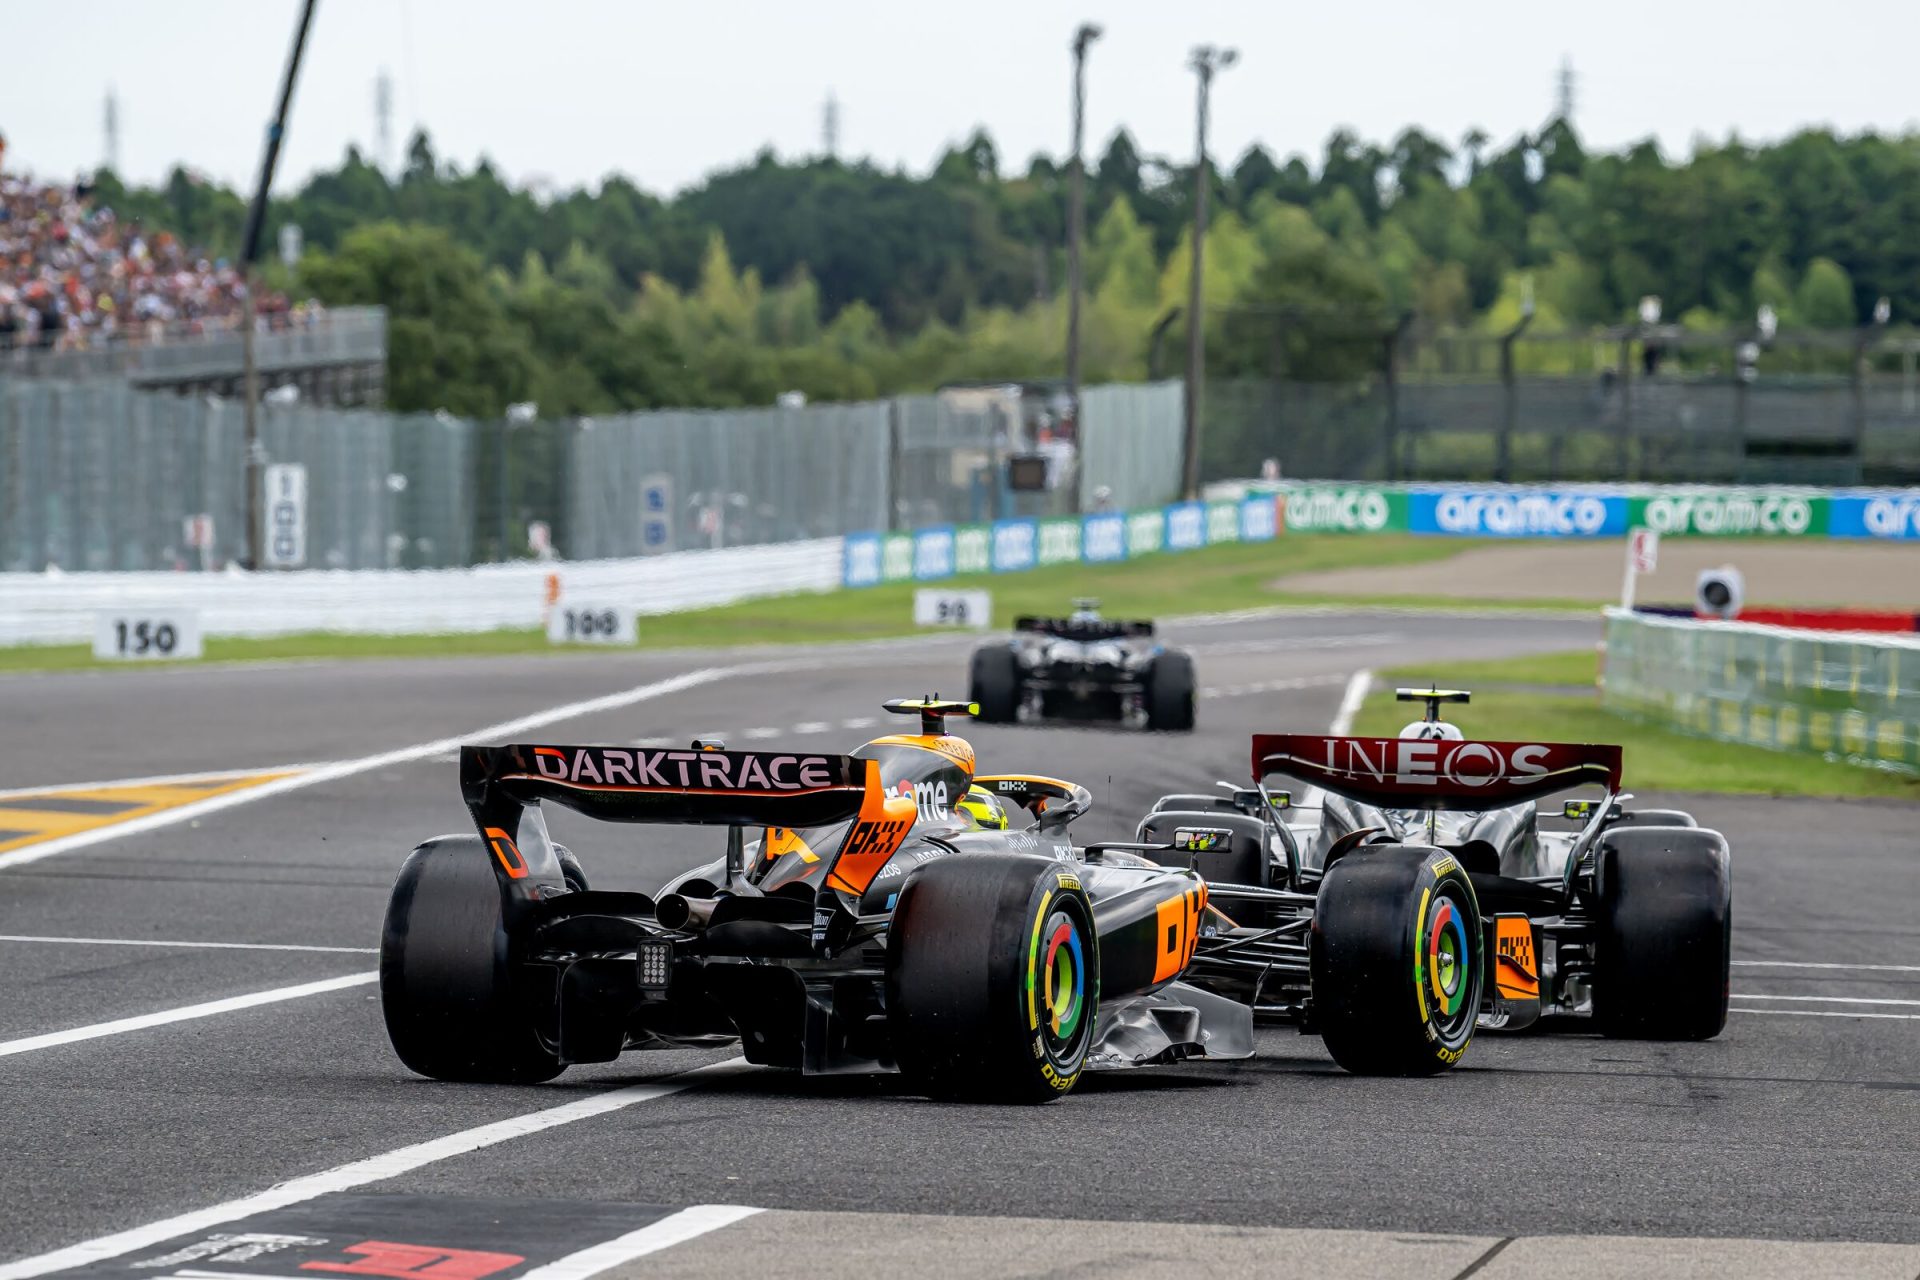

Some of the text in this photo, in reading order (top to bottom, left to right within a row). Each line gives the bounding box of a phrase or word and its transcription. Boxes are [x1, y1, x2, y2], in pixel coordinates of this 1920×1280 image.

[1435, 495, 1607, 534] aramco
[1645, 498, 1812, 536] aramco
[1863, 499, 1920, 537] ar
[116, 620, 176, 655] 150
[563, 609, 619, 636] 100
[534, 747, 831, 790] DARKTRACE
[1323, 739, 1551, 788] INEOS
[998, 780, 1027, 791] OKX
[845, 820, 905, 855] OKX
[1056, 873, 1081, 891] PIRELLI
[1433, 856, 1456, 878] PIRELLI
[1041, 1063, 1078, 1091] ZERO
